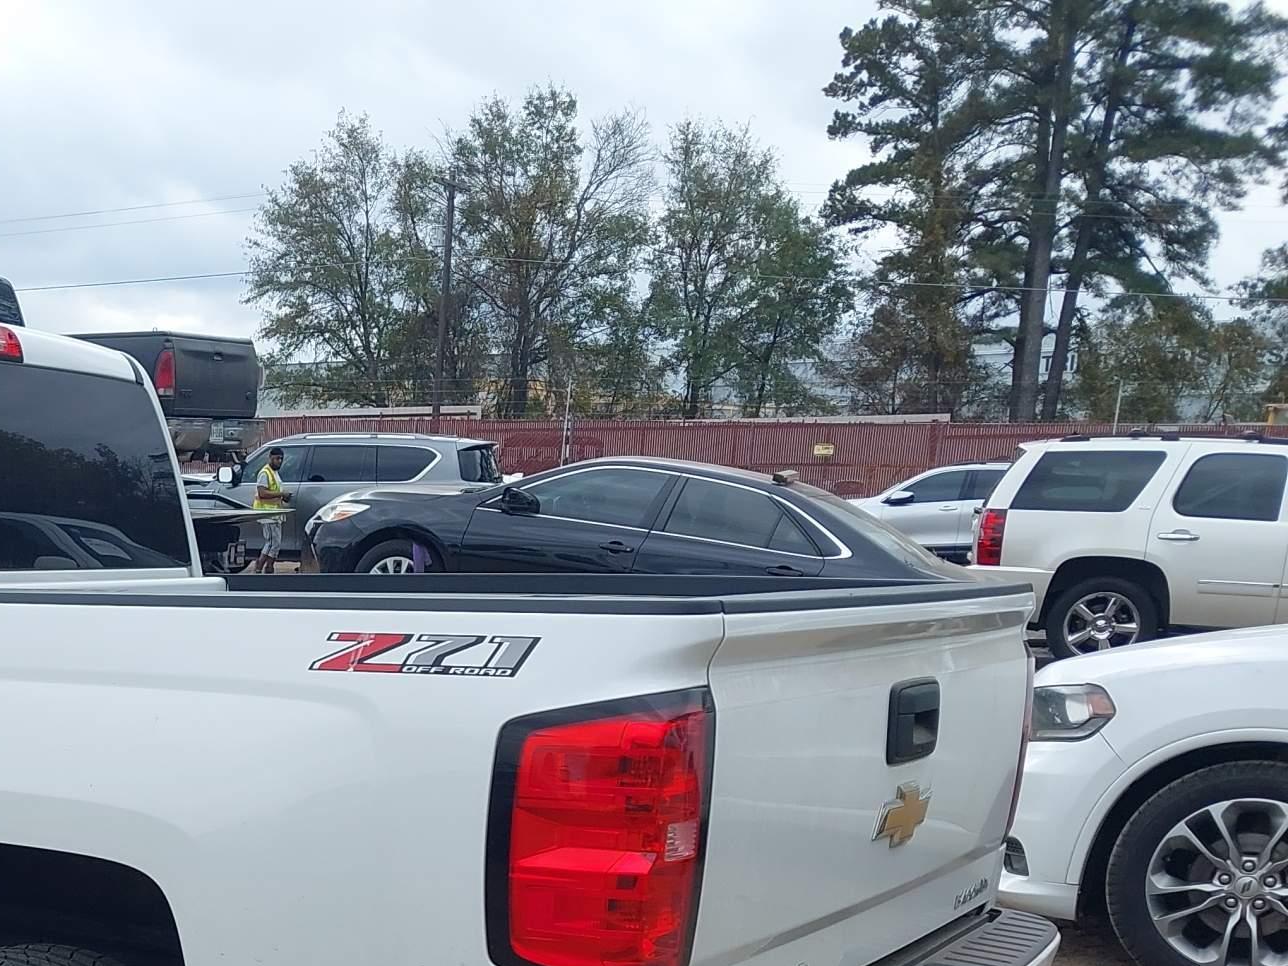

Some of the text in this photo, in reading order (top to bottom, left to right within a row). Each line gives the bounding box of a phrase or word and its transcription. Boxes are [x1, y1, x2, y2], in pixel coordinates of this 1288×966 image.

[309, 632, 542, 678] Z71
[402, 665, 513, 677] OFF ROAD
